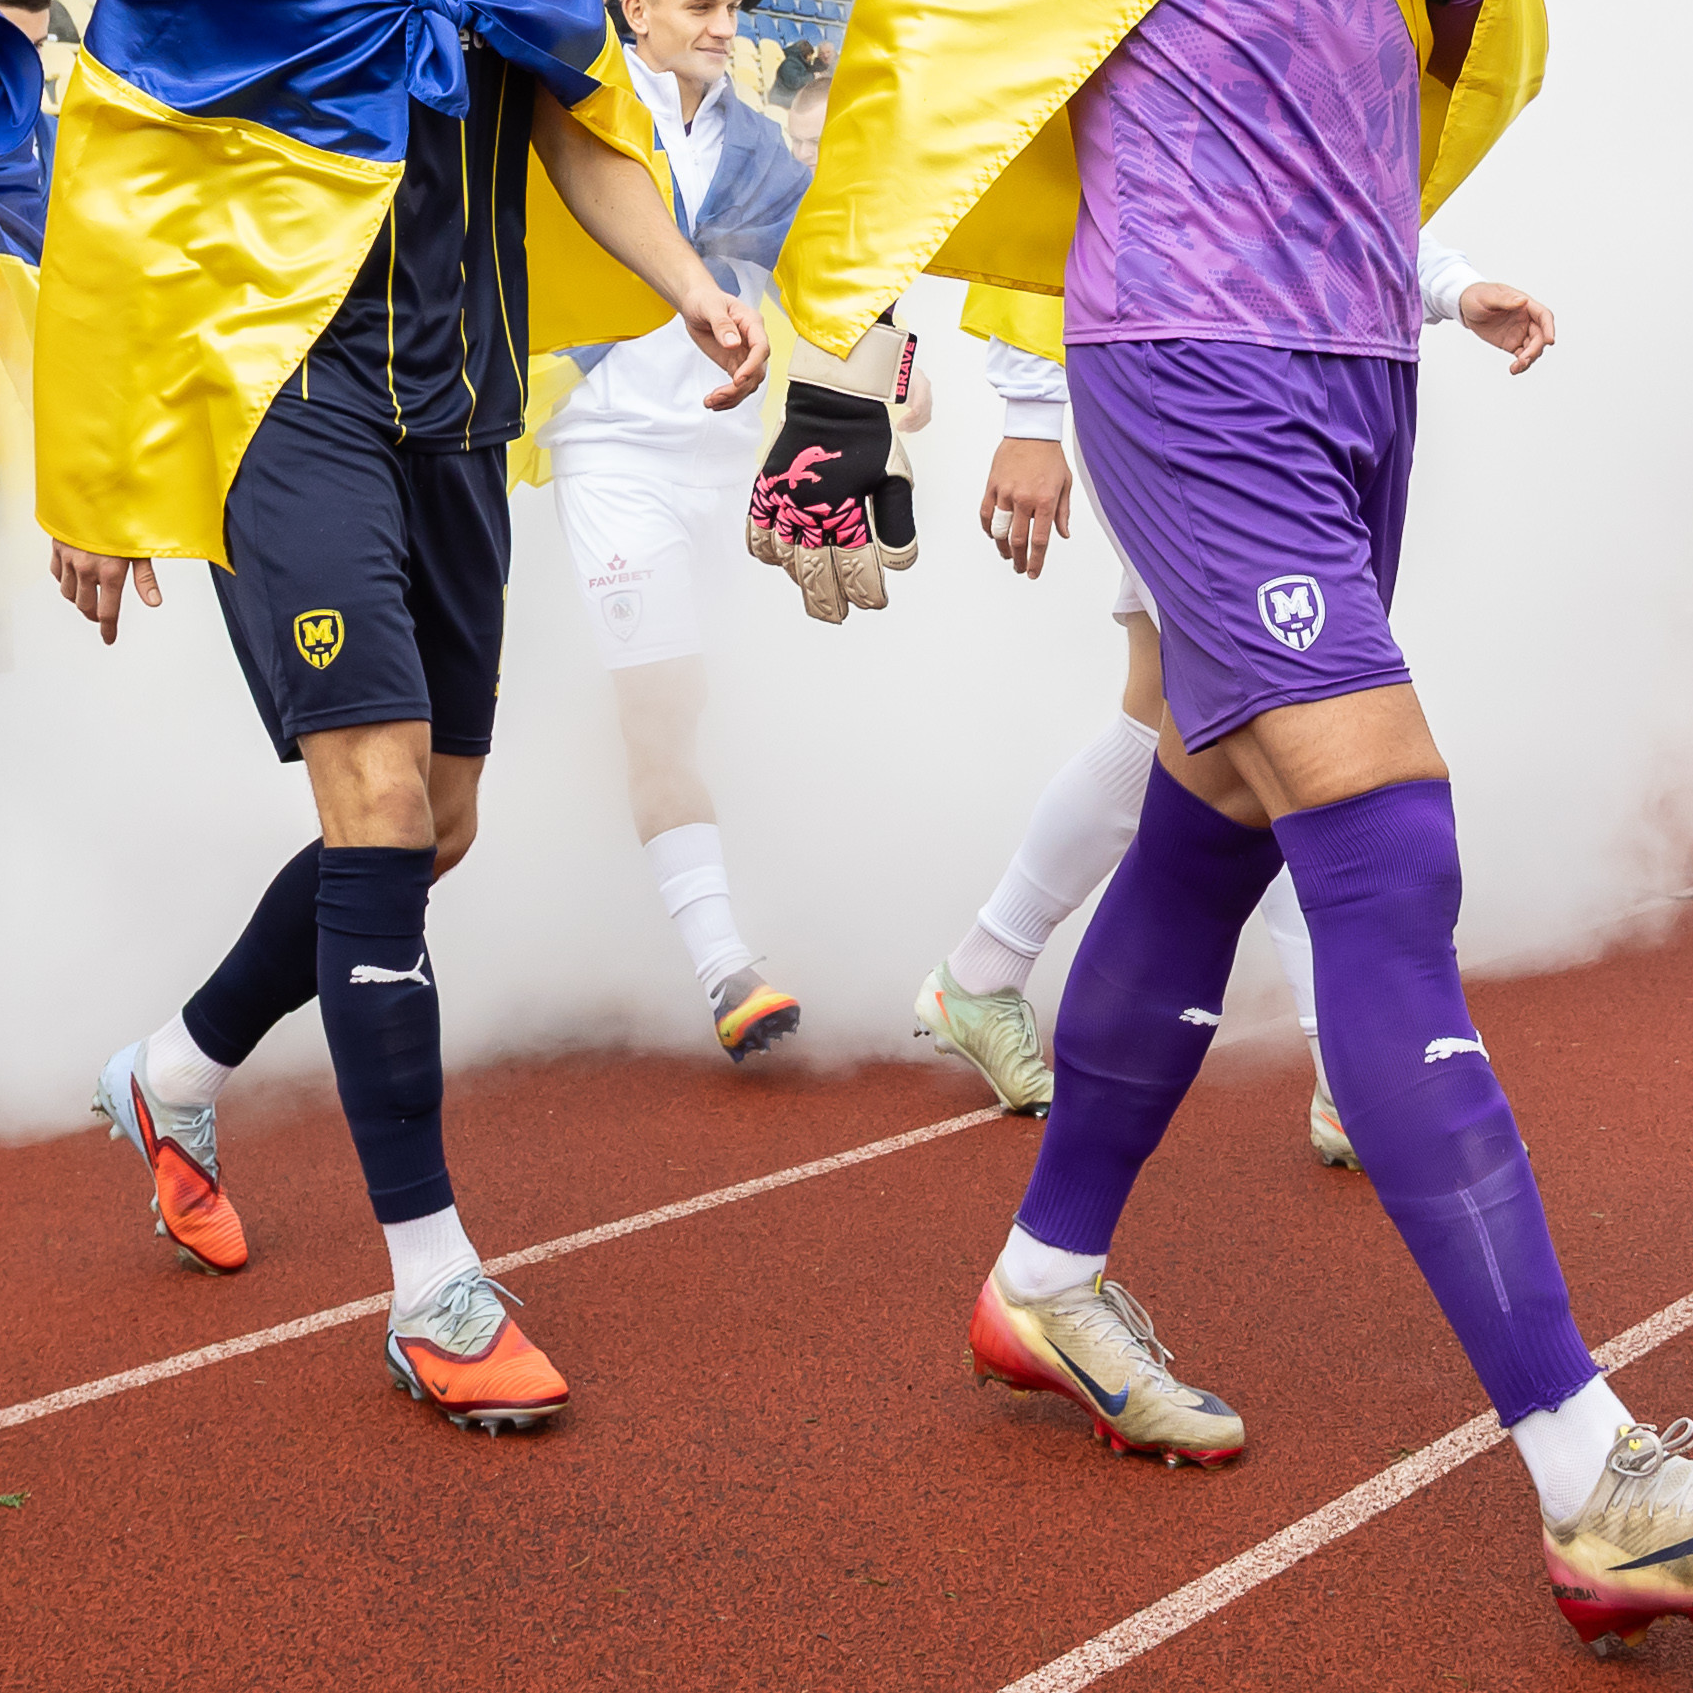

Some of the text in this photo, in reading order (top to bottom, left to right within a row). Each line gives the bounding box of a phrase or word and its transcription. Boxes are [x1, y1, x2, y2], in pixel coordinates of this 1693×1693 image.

[896, 341, 916, 397] BRAVE
[588, 569, 655, 589] FAVBET
[1269, 585, 1315, 624] M
[302, 618, 335, 647] M
